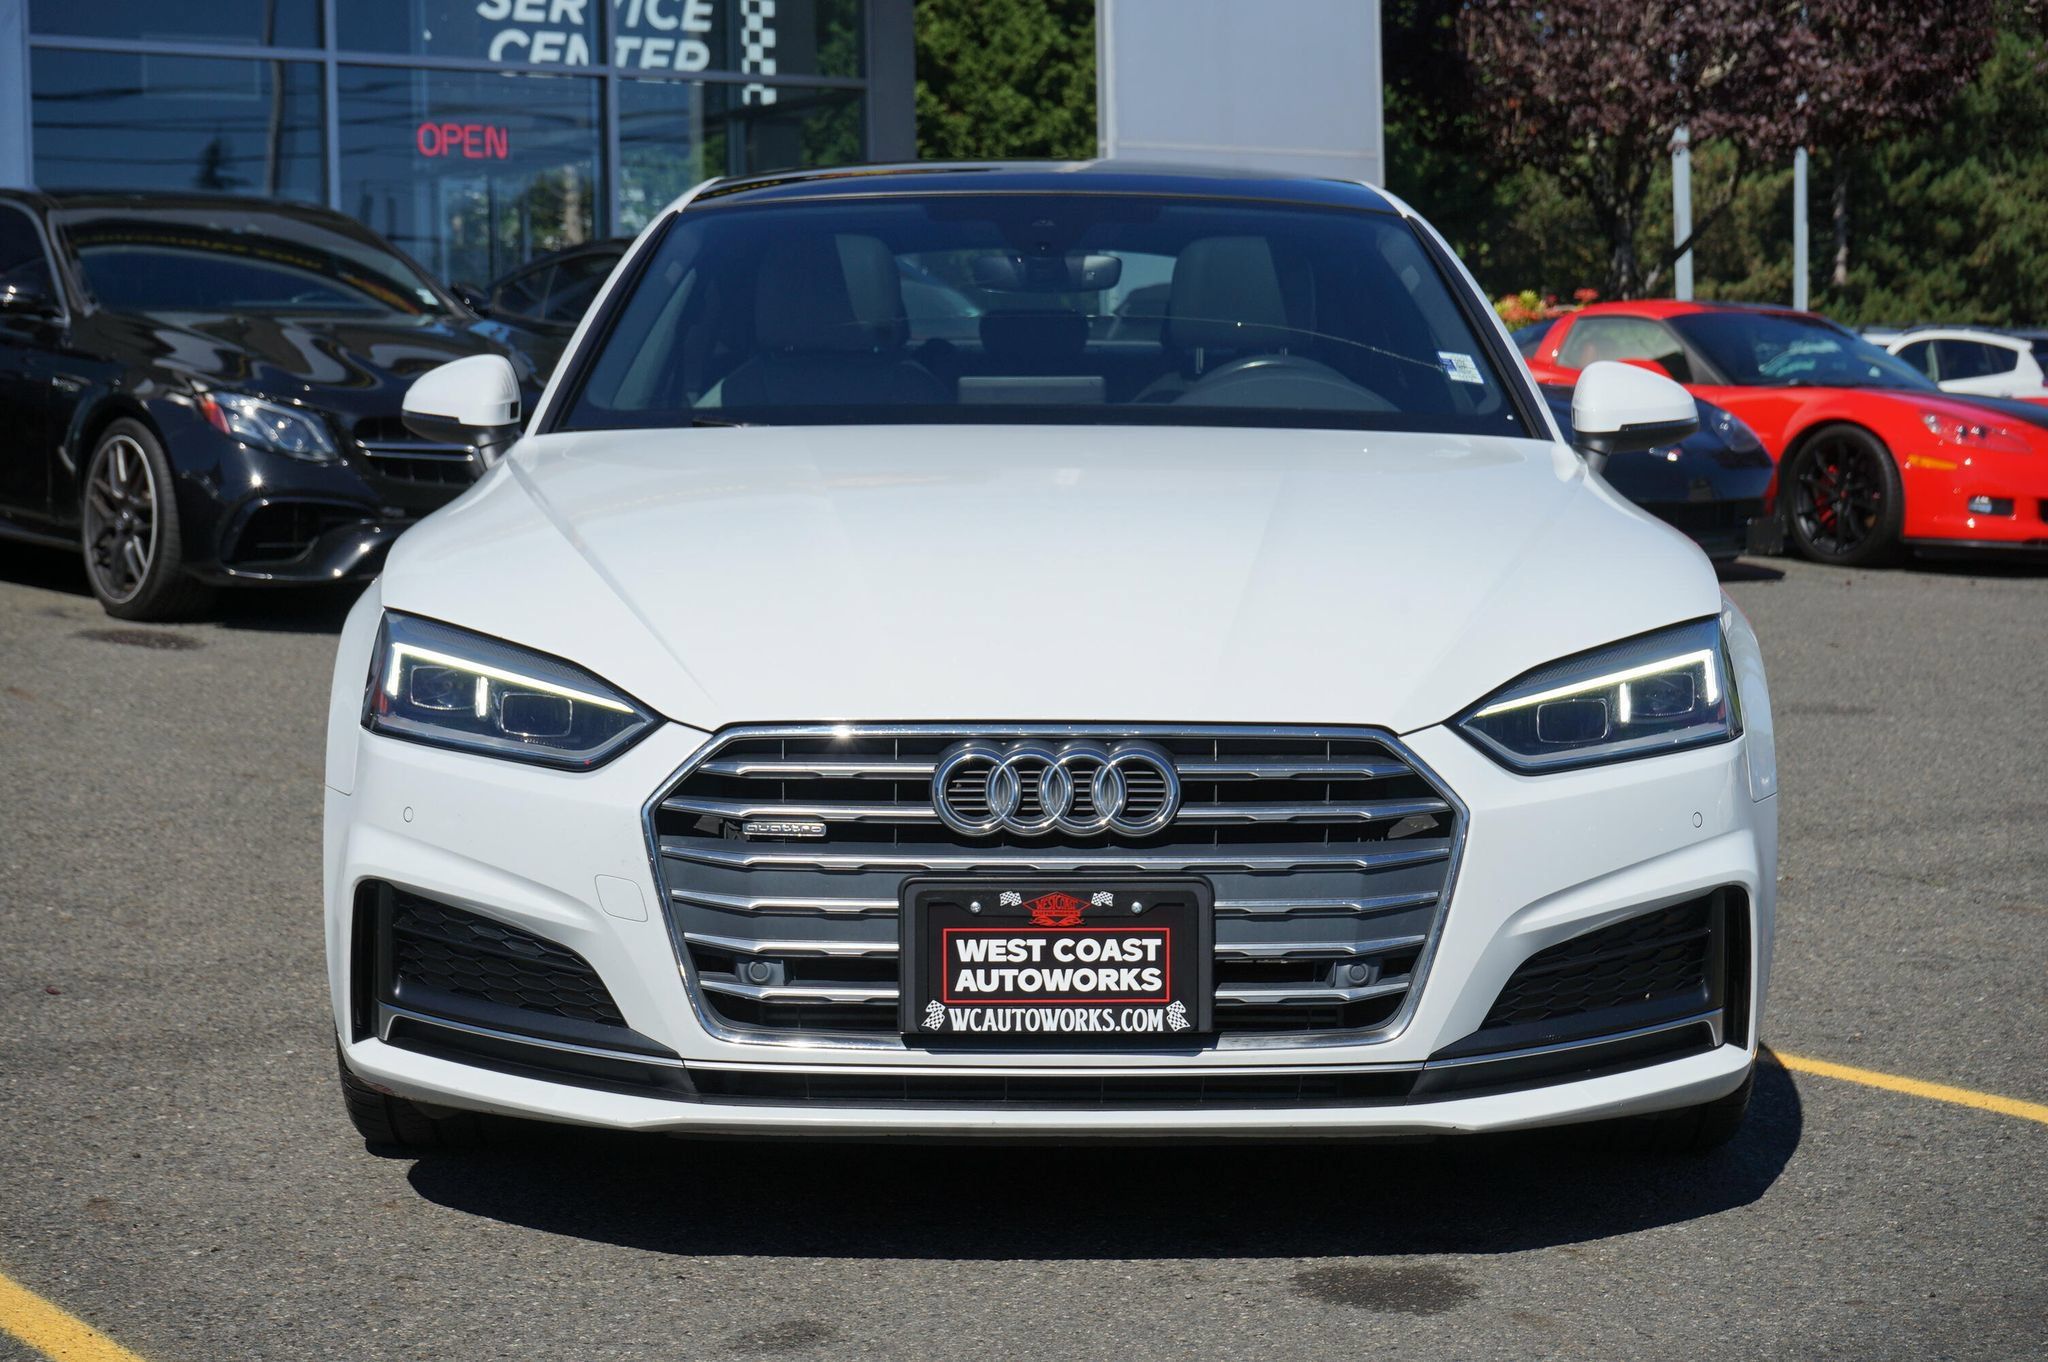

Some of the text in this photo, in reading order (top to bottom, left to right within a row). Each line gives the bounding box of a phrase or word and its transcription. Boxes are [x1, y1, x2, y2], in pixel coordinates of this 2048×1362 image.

[476, 0, 713, 32] SERICE
[416, 121, 508, 159] OPEN
[746, 824, 822, 833] quattro
[955, 937, 1162, 962] WEST COAST
[954, 968, 1162, 992] AUTOWORKS
[949, 1008, 1164, 1032] WCAUTOWORKS.COM
